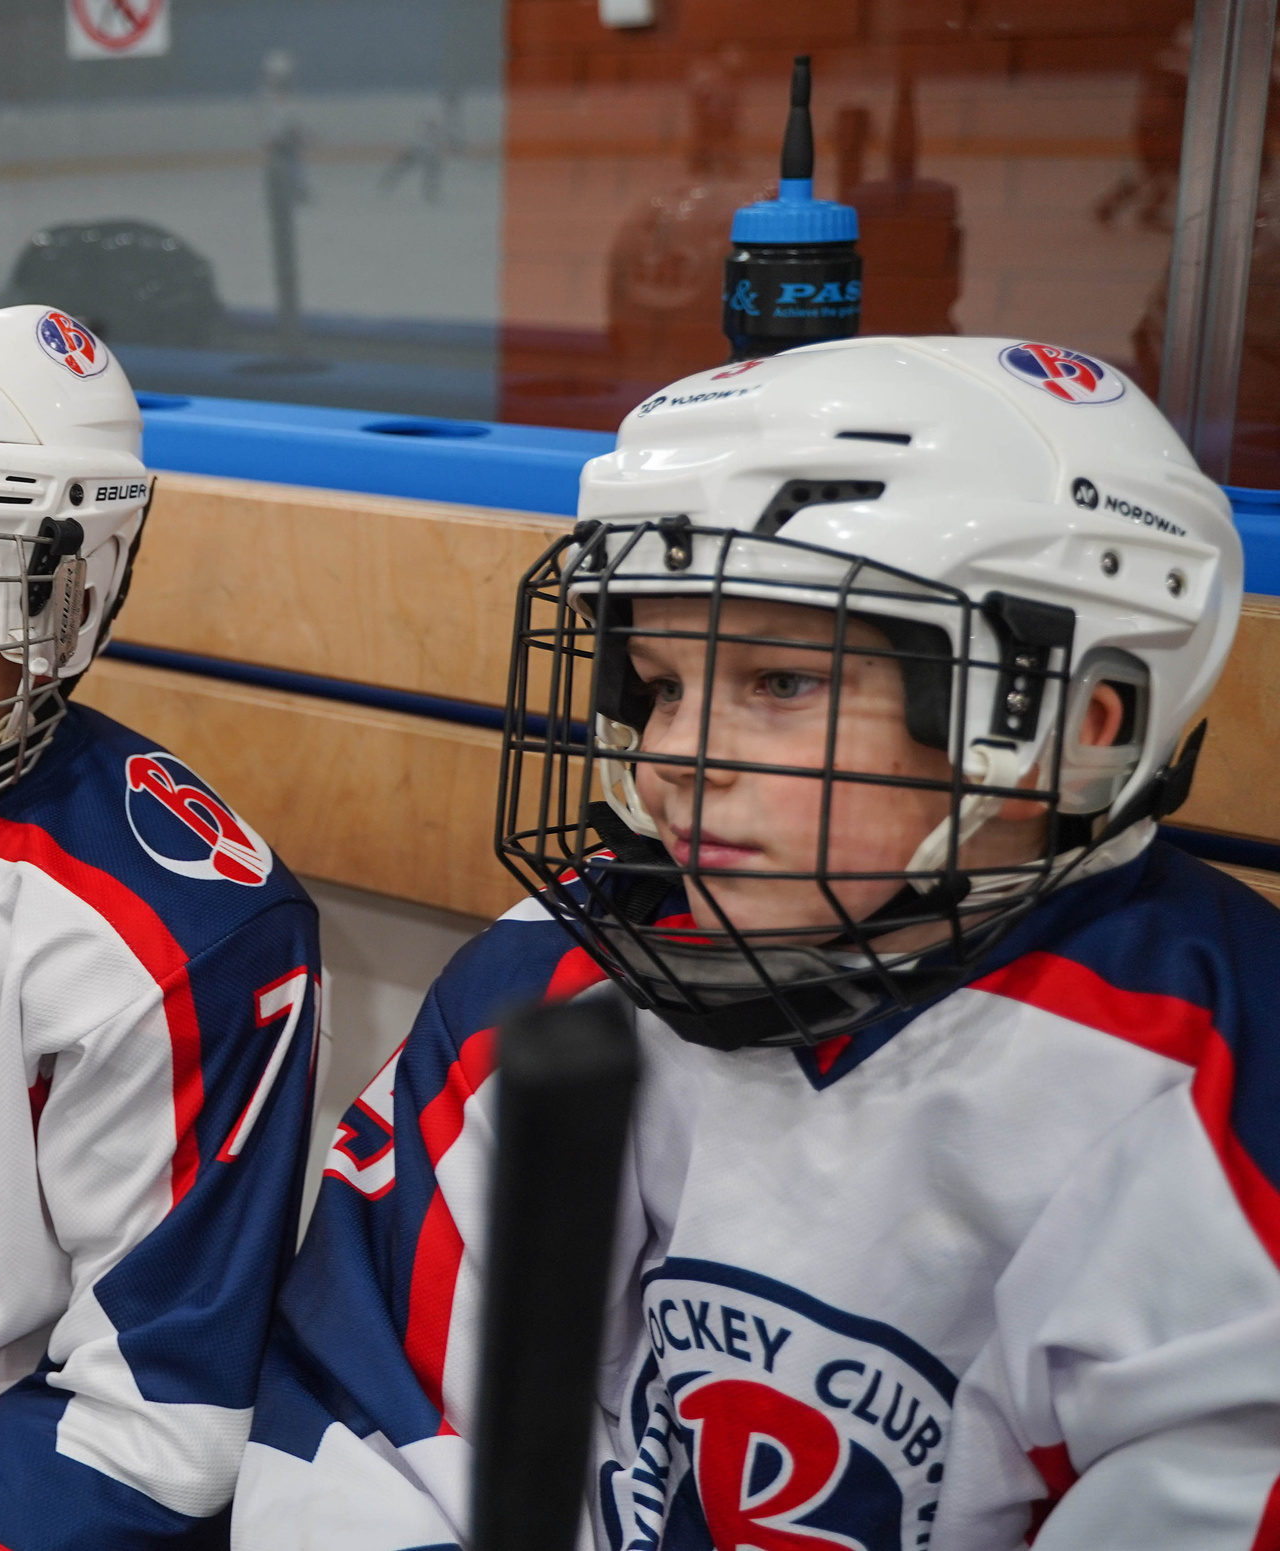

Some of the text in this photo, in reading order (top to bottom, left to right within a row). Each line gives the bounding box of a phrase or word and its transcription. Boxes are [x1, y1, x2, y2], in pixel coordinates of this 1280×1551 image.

[95, 483, 148, 502] BAUER
[1105, 495, 1187, 538] NORDWAY
[814, 1358, 942, 1467] CLUB
